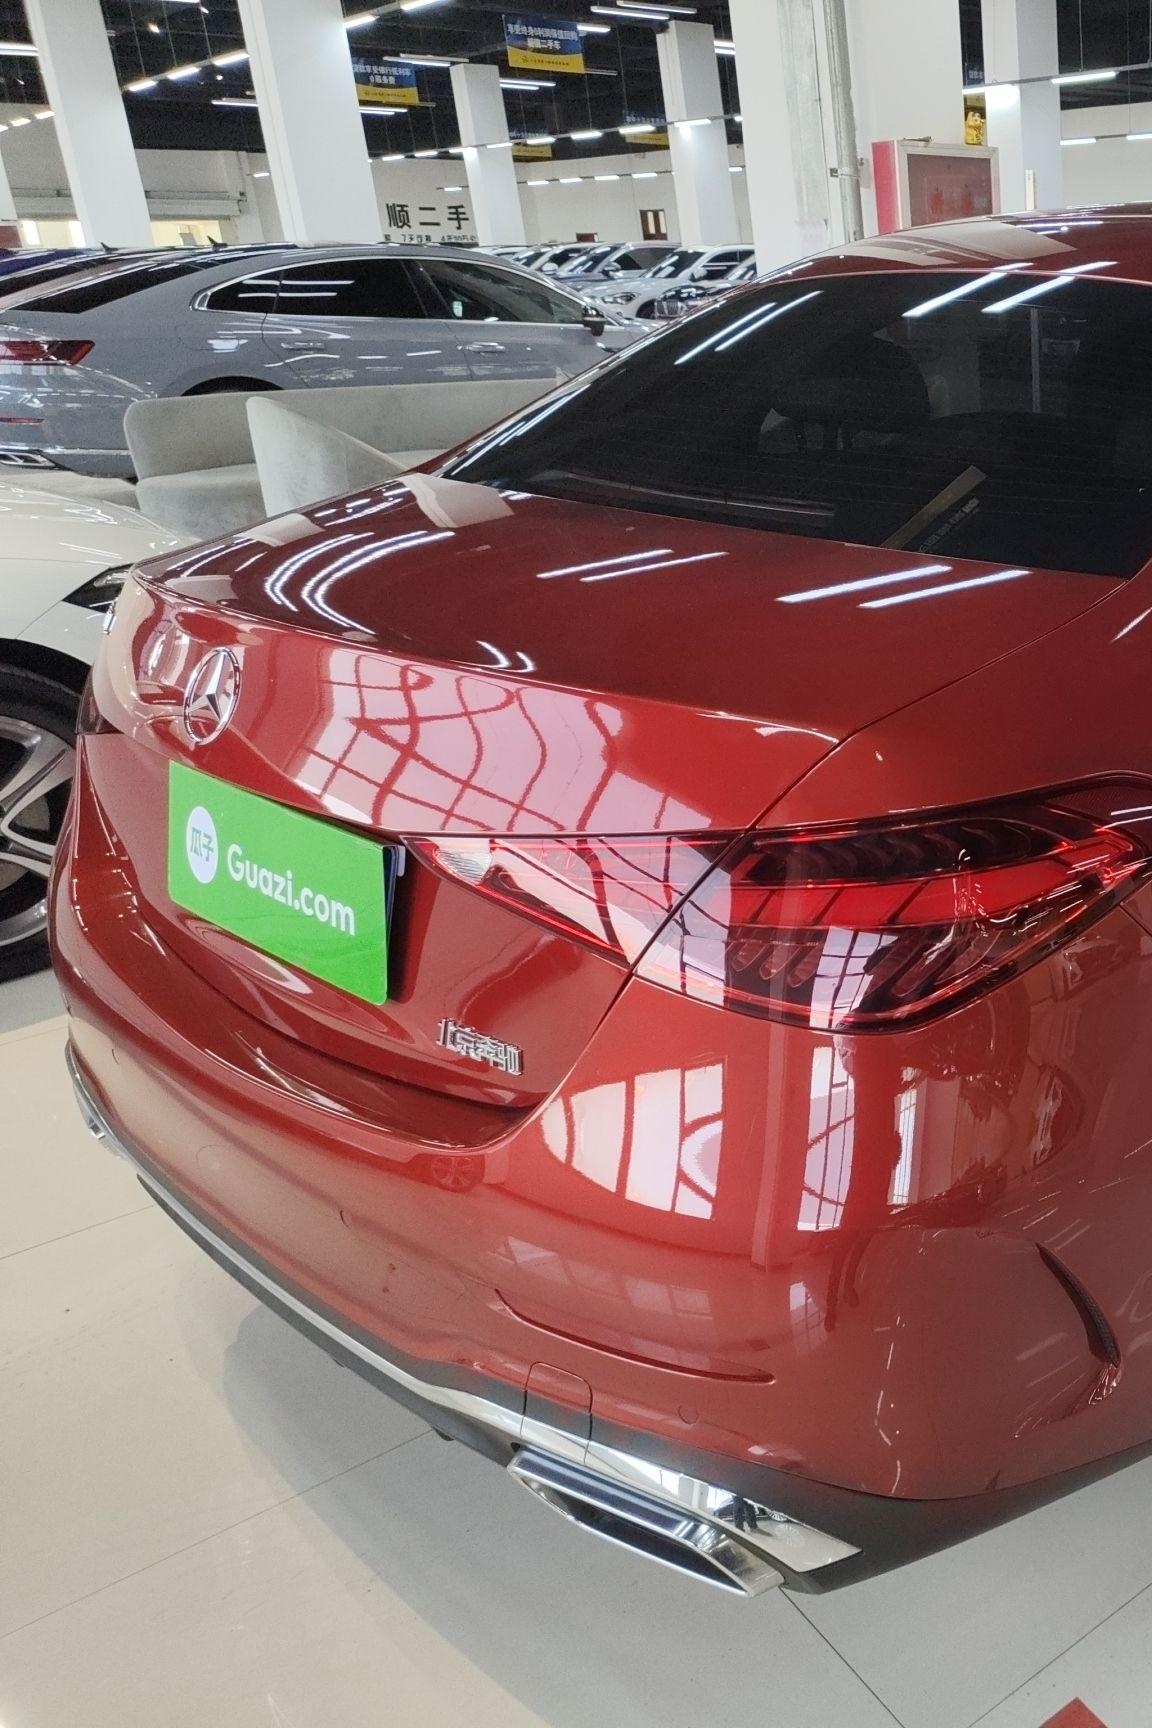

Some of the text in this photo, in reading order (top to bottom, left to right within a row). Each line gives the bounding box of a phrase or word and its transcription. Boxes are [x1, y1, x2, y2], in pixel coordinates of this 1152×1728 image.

[190, 827, 215, 863] 瓜子
[227, 843, 356, 937] Guazi.com
[436, 1018, 522, 1076] 北京奔驰
